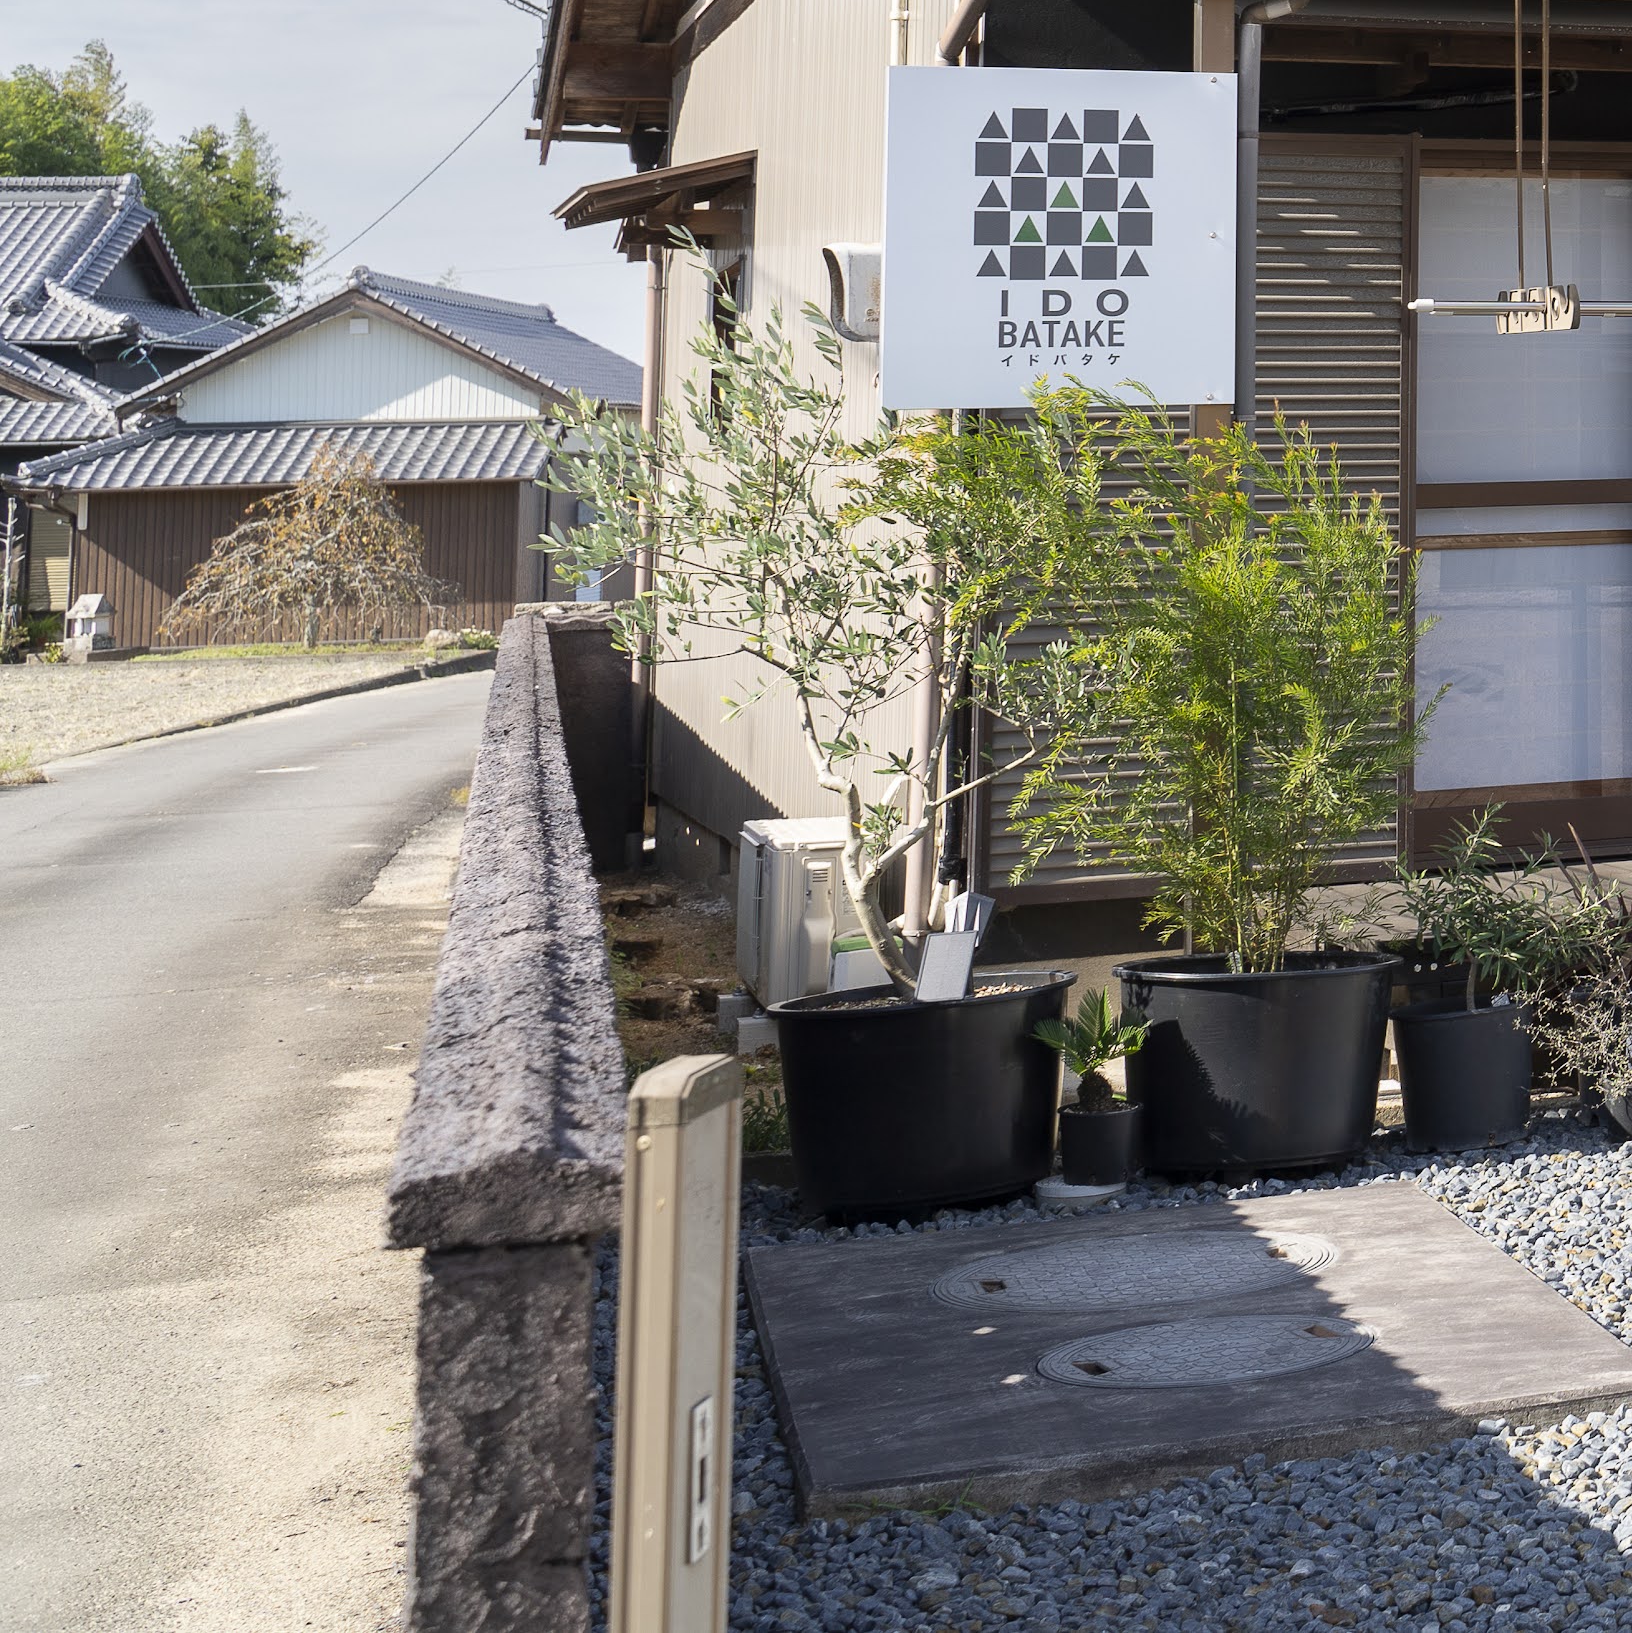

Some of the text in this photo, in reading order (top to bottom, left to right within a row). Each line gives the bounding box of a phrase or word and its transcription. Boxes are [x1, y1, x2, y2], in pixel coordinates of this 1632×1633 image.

[1001, 289, 1129, 317] IDO
[998, 320, 1125, 348] BATAKE
[1001, 353, 1120, 367] イドバタケ
